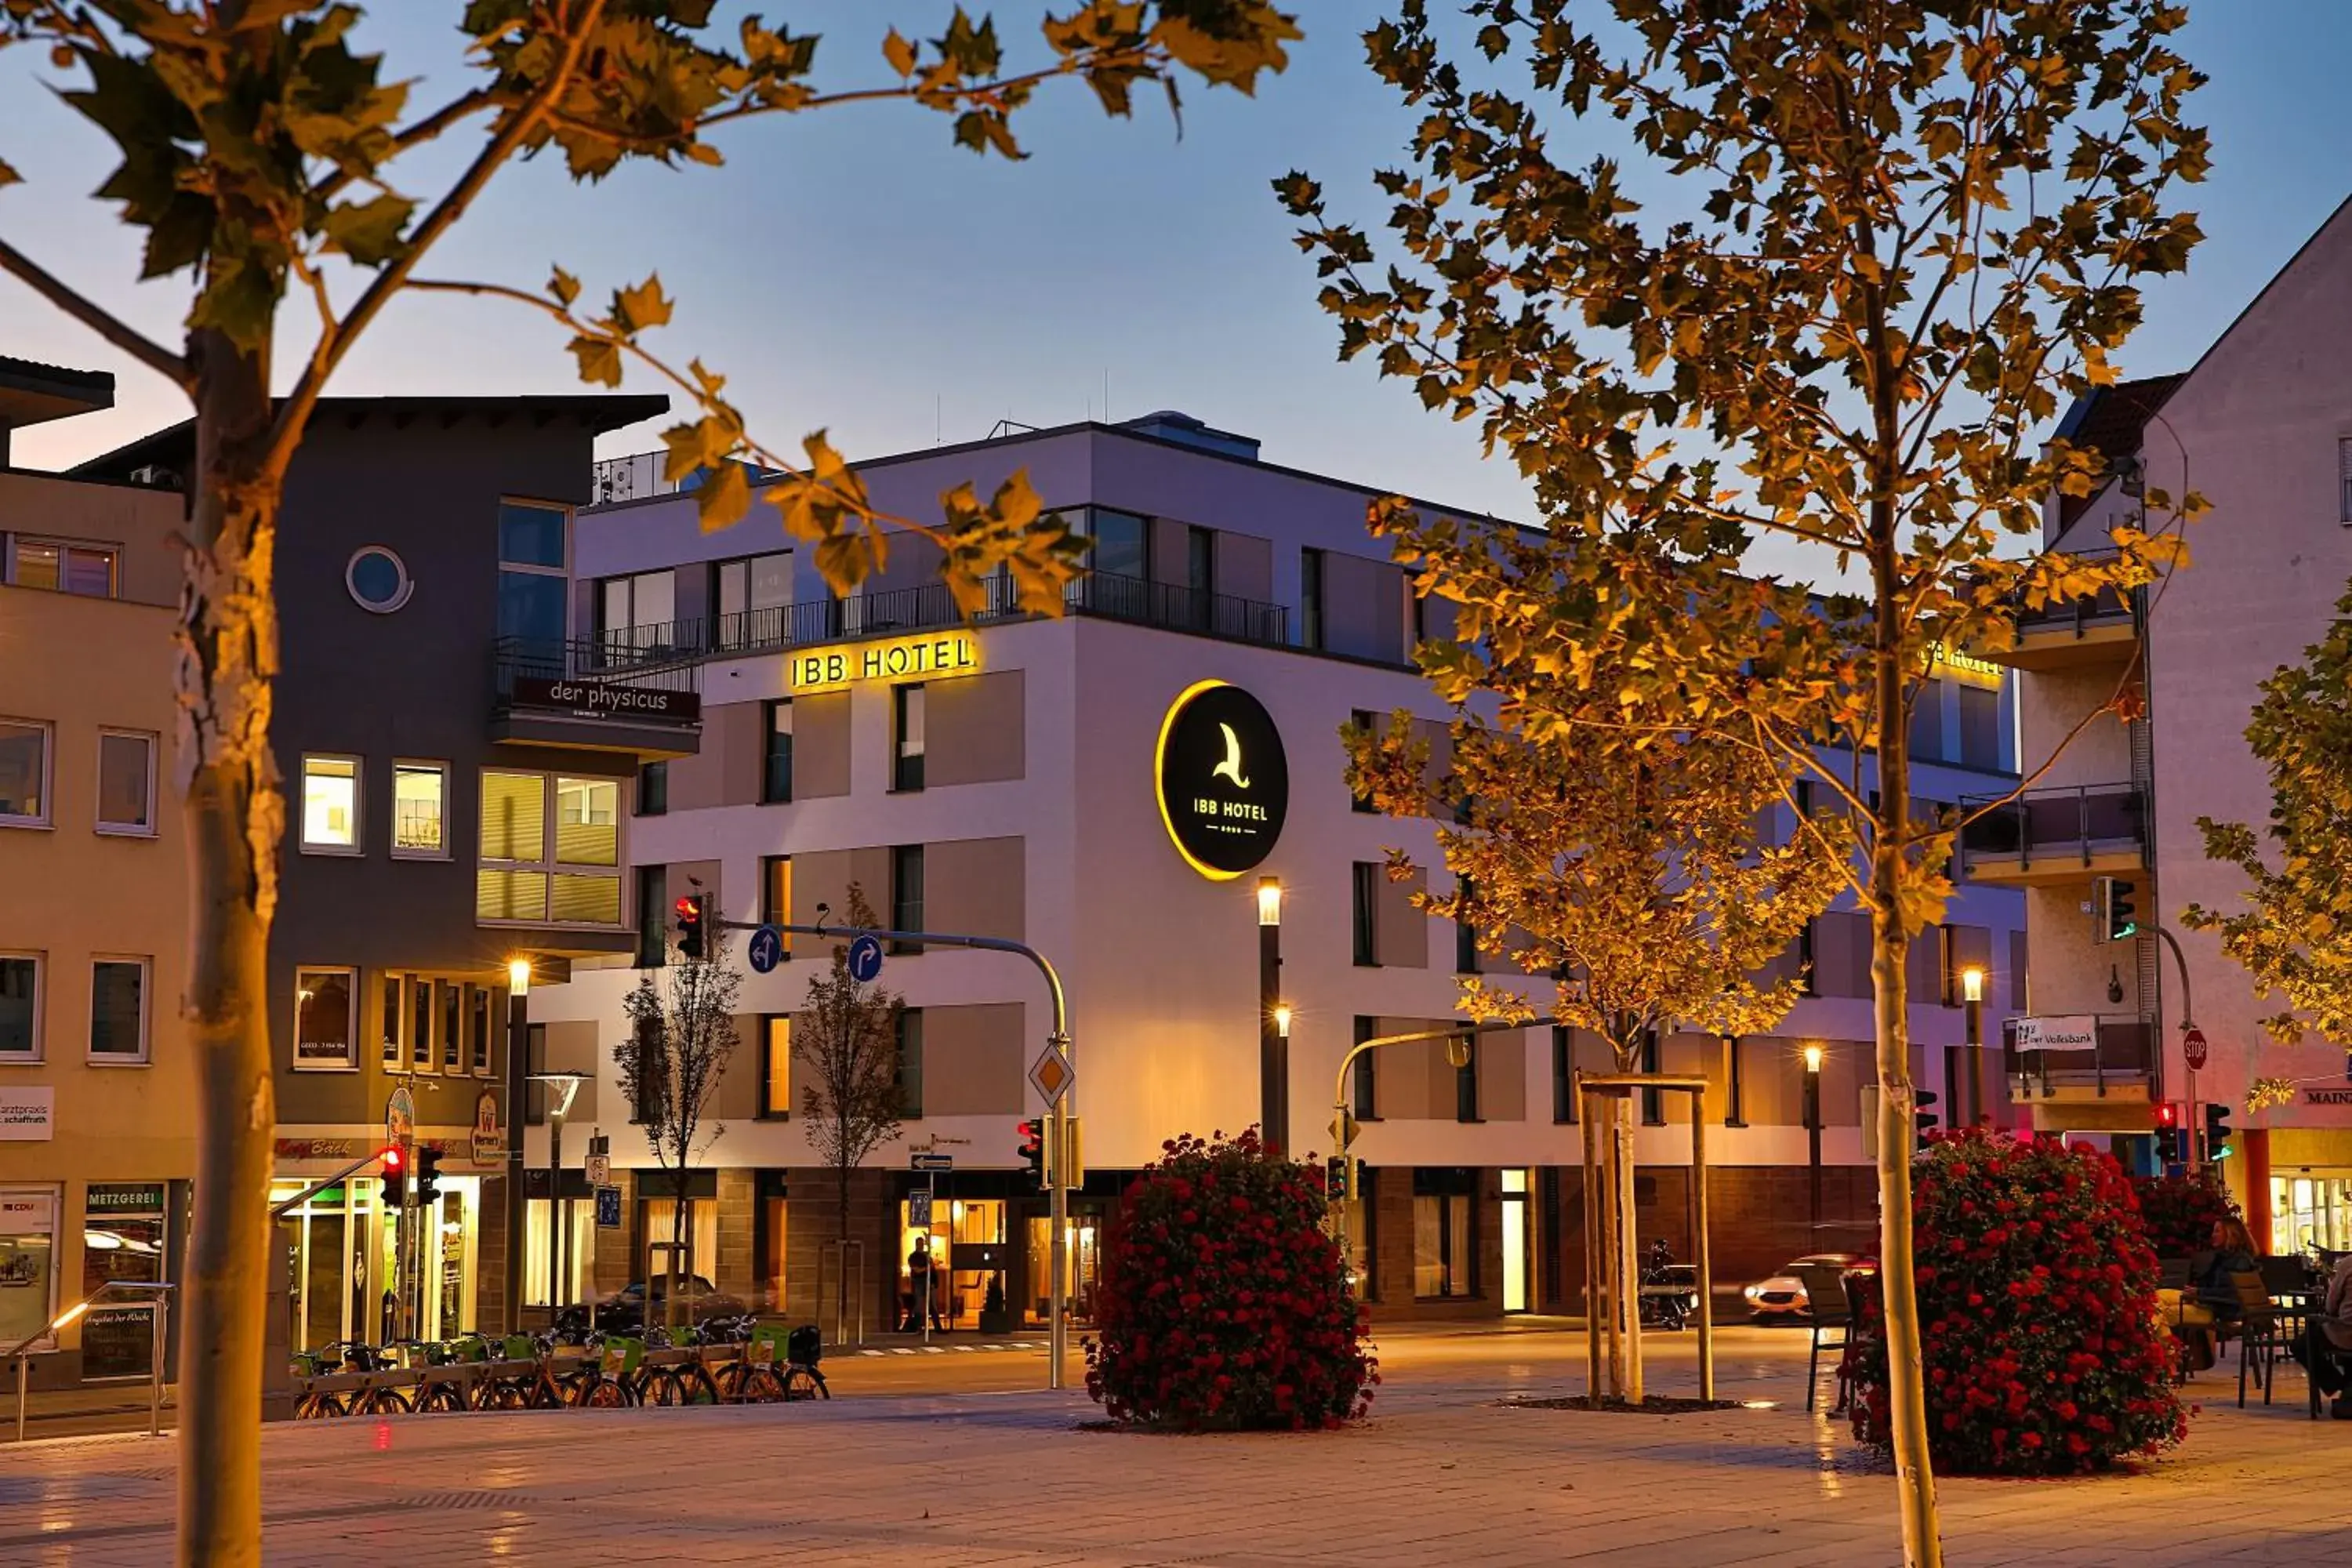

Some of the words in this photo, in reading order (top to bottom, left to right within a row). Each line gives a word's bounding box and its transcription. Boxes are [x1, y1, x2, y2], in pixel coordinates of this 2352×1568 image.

[793, 655, 844, 687] IBB
[863, 639, 972, 678] HOTEL
[551, 681, 583, 701] der
[589, 684, 667, 710] physicus
[1194, 798, 1218, 815] IBB
[1223, 802, 1268, 821] HOTEL
[2045, 1033, 2092, 1044] Volksbank
[2185, 1040, 2205, 1058] STOP
[89, 1192, 155, 1205] METZGEREI
